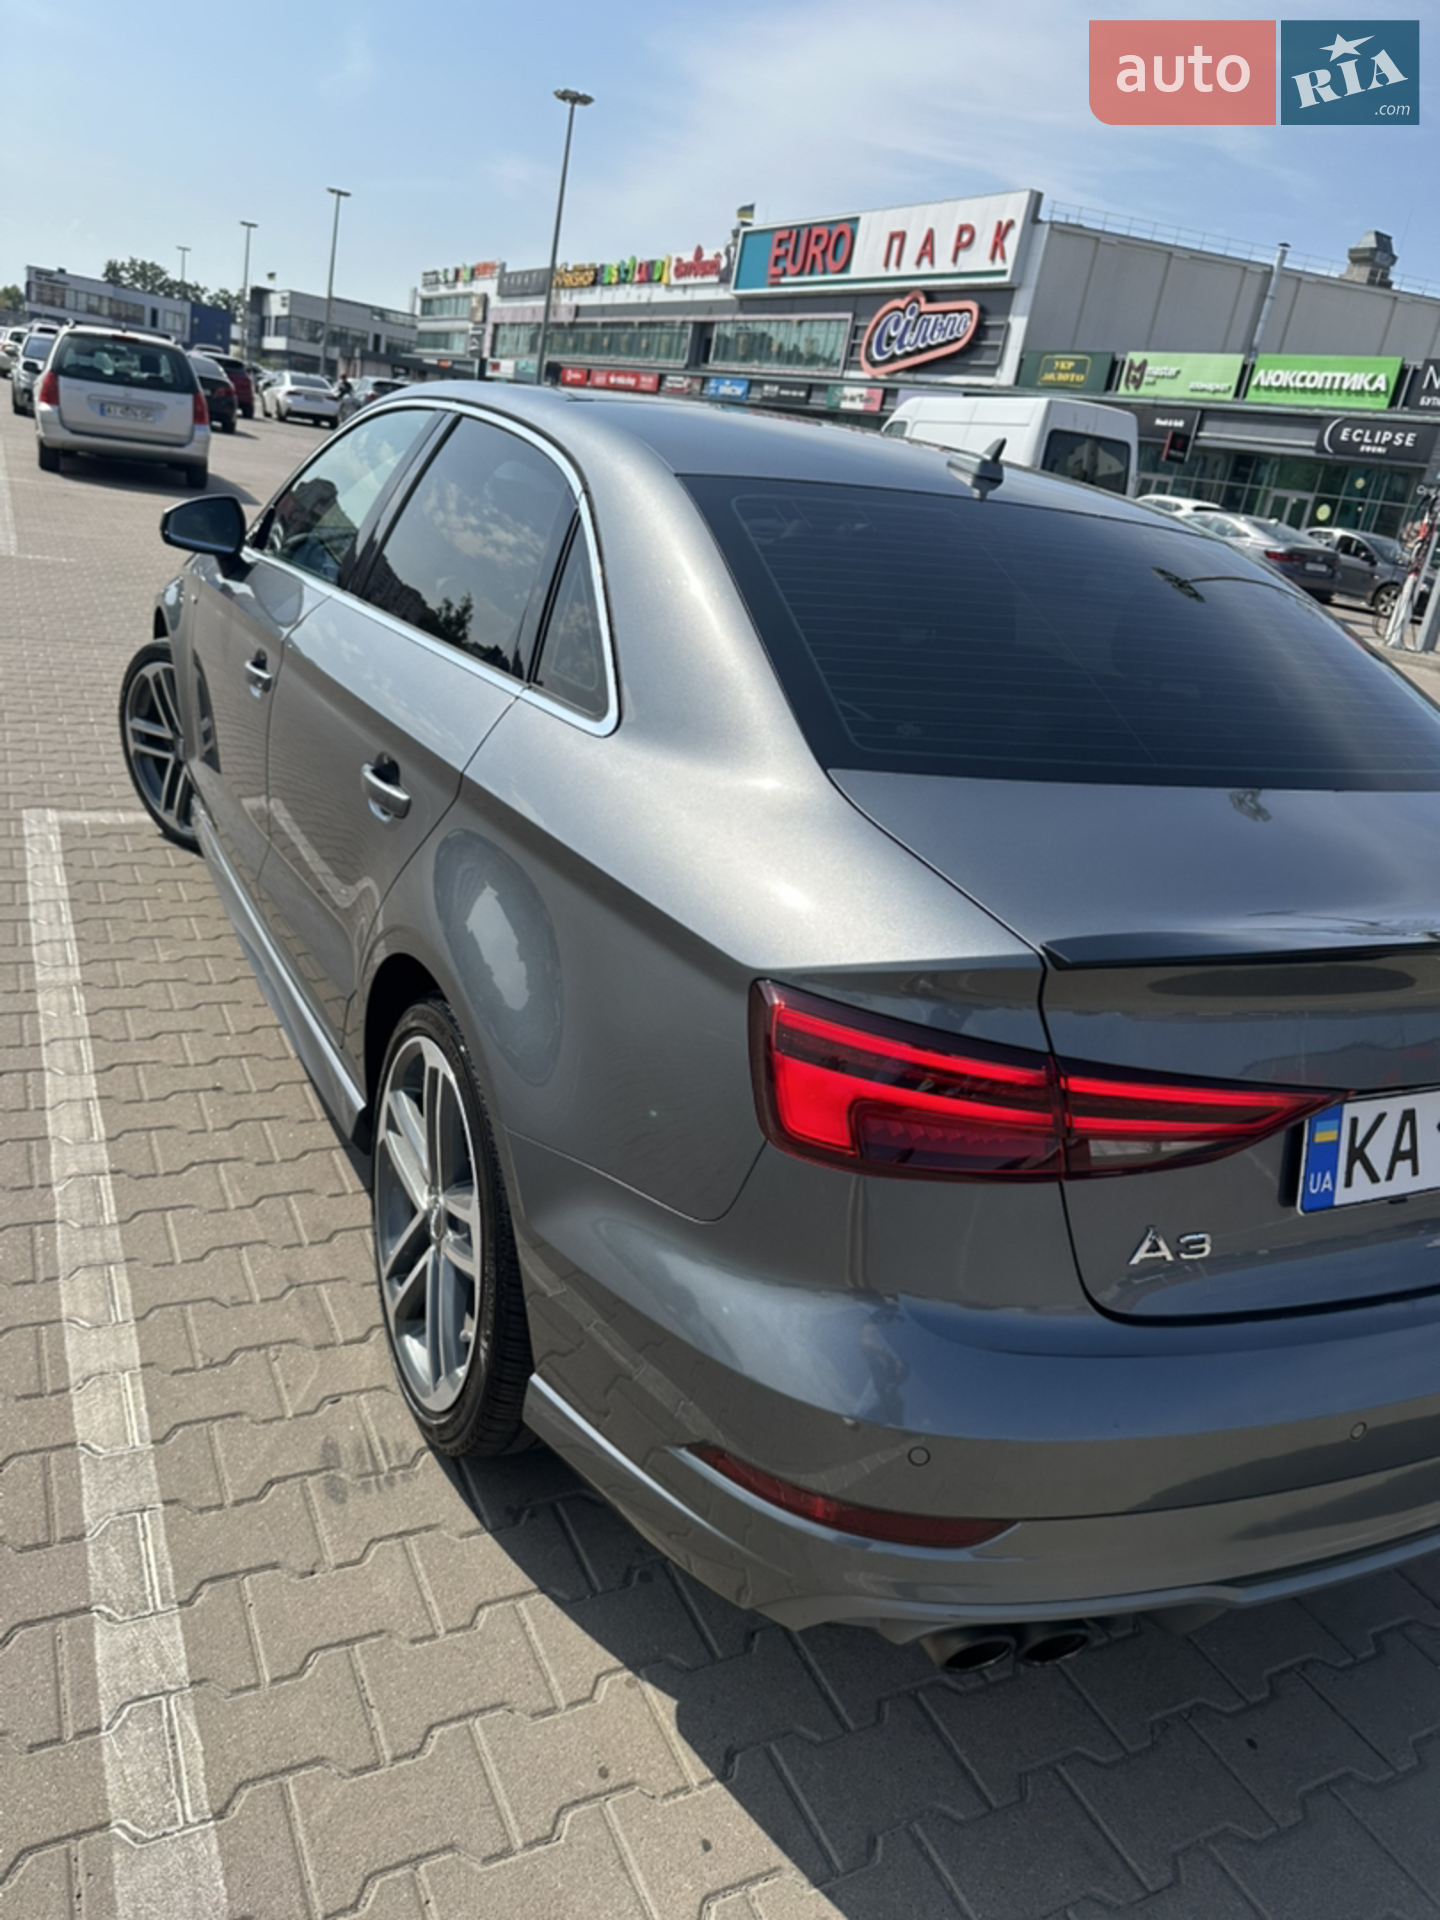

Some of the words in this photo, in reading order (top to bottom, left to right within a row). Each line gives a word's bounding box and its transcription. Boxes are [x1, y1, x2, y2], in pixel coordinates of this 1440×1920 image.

[770, 223, 853, 275] EURO
[883, 219, 1013, 269] ПАРК
[872, 303, 971, 360] Сільпо
[1252, 369, 1387, 391] ЛЮКСОПТИКА
[1340, 427, 1417, 447] ECLIPSE
[1309, 1171, 1333, 1194] UA
[1128, 1226, 1212, 1266] A3
